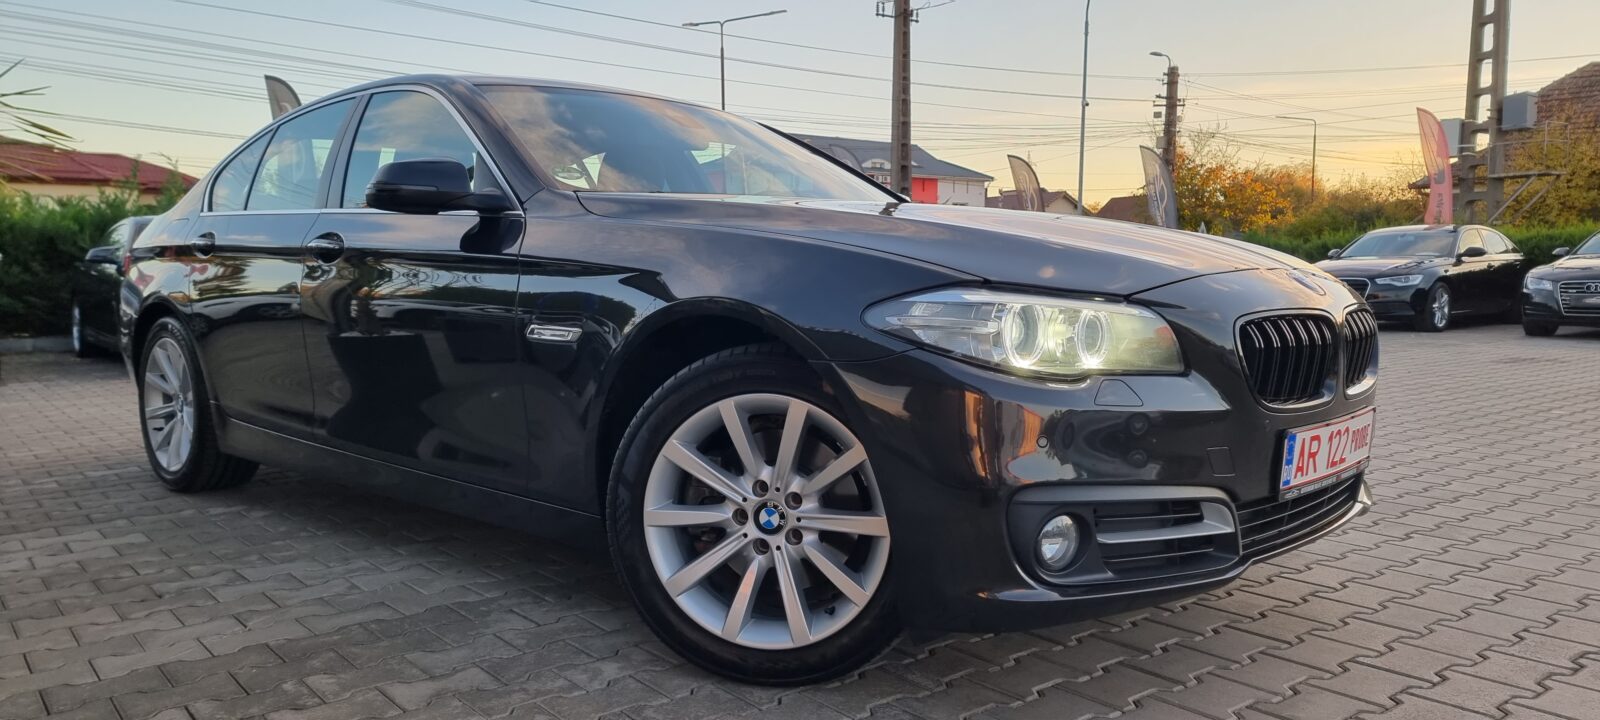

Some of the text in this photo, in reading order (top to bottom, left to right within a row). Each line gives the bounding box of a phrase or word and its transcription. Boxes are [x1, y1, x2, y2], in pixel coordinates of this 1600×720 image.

[1294, 423, 1370, 479] AR 122 PROBE
